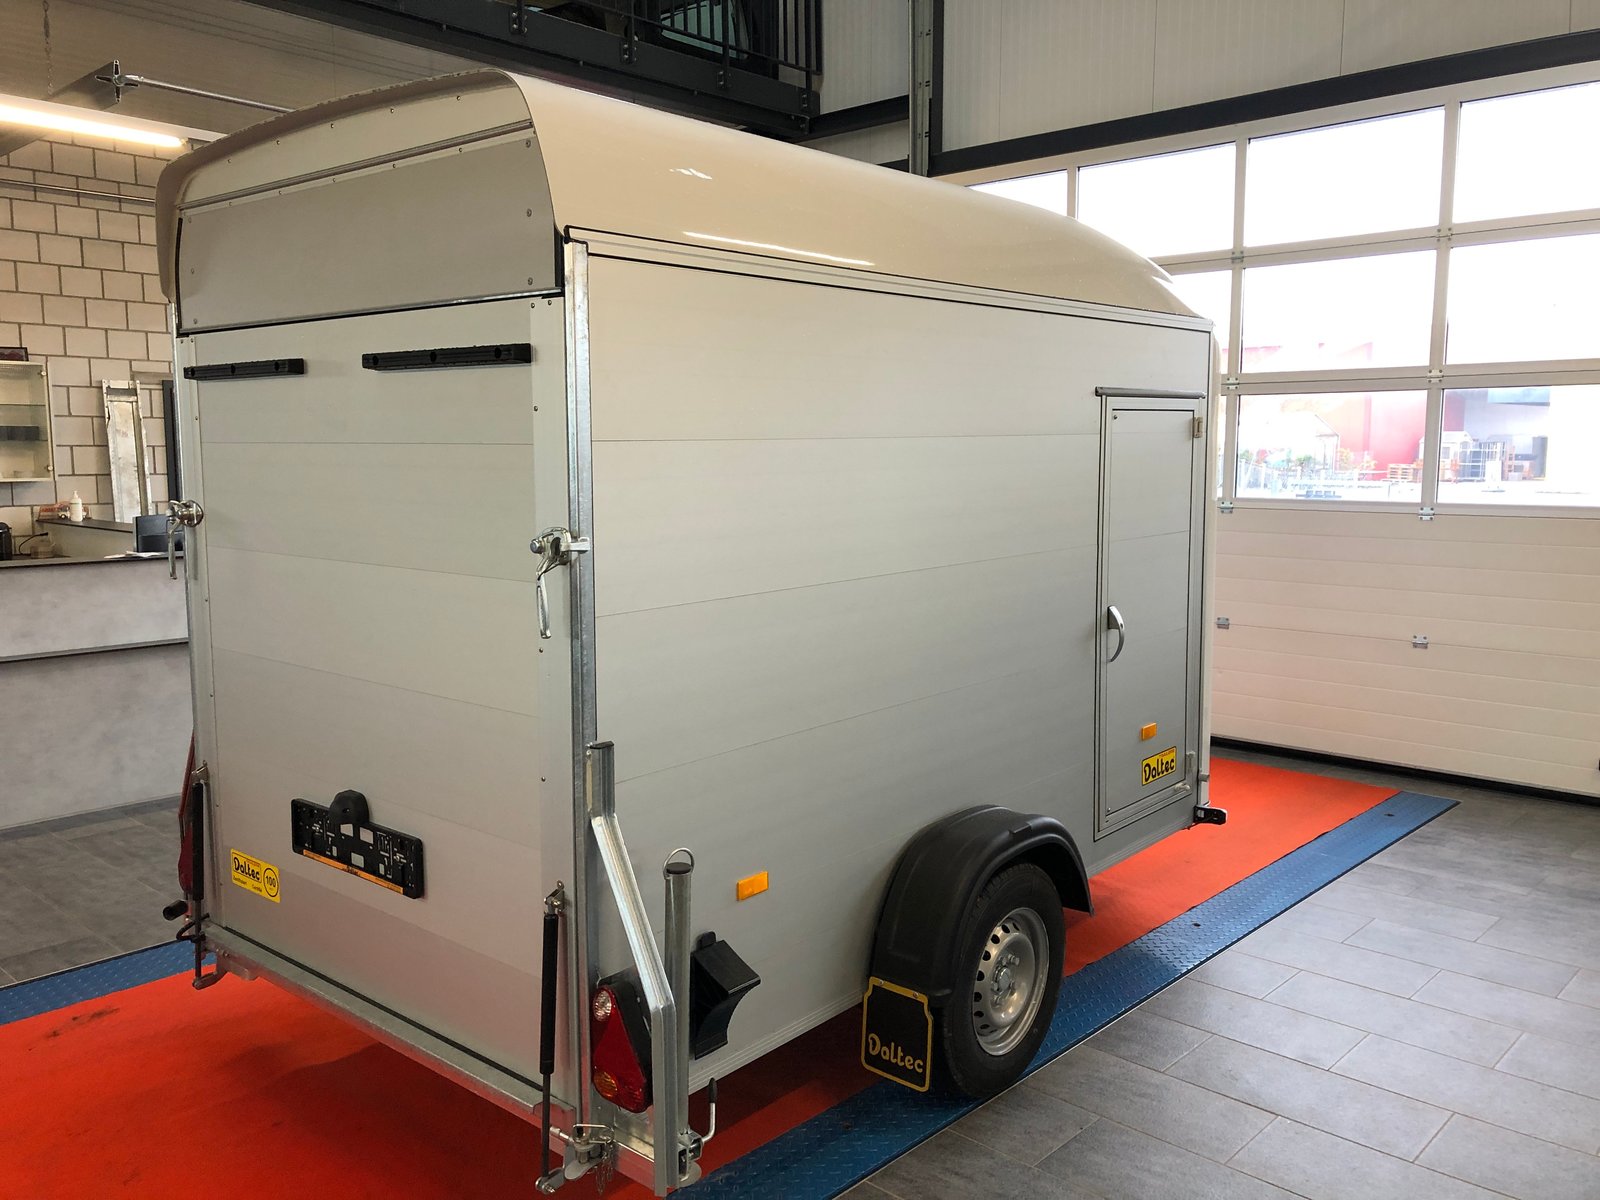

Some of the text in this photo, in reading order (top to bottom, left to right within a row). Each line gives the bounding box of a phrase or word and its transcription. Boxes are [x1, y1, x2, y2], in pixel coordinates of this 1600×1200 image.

[1143, 758, 1175, 782] Daltec
[233, 856, 260, 881] Daltec
[265, 875, 277, 888] 100
[868, 1033, 924, 1073] Daltec
